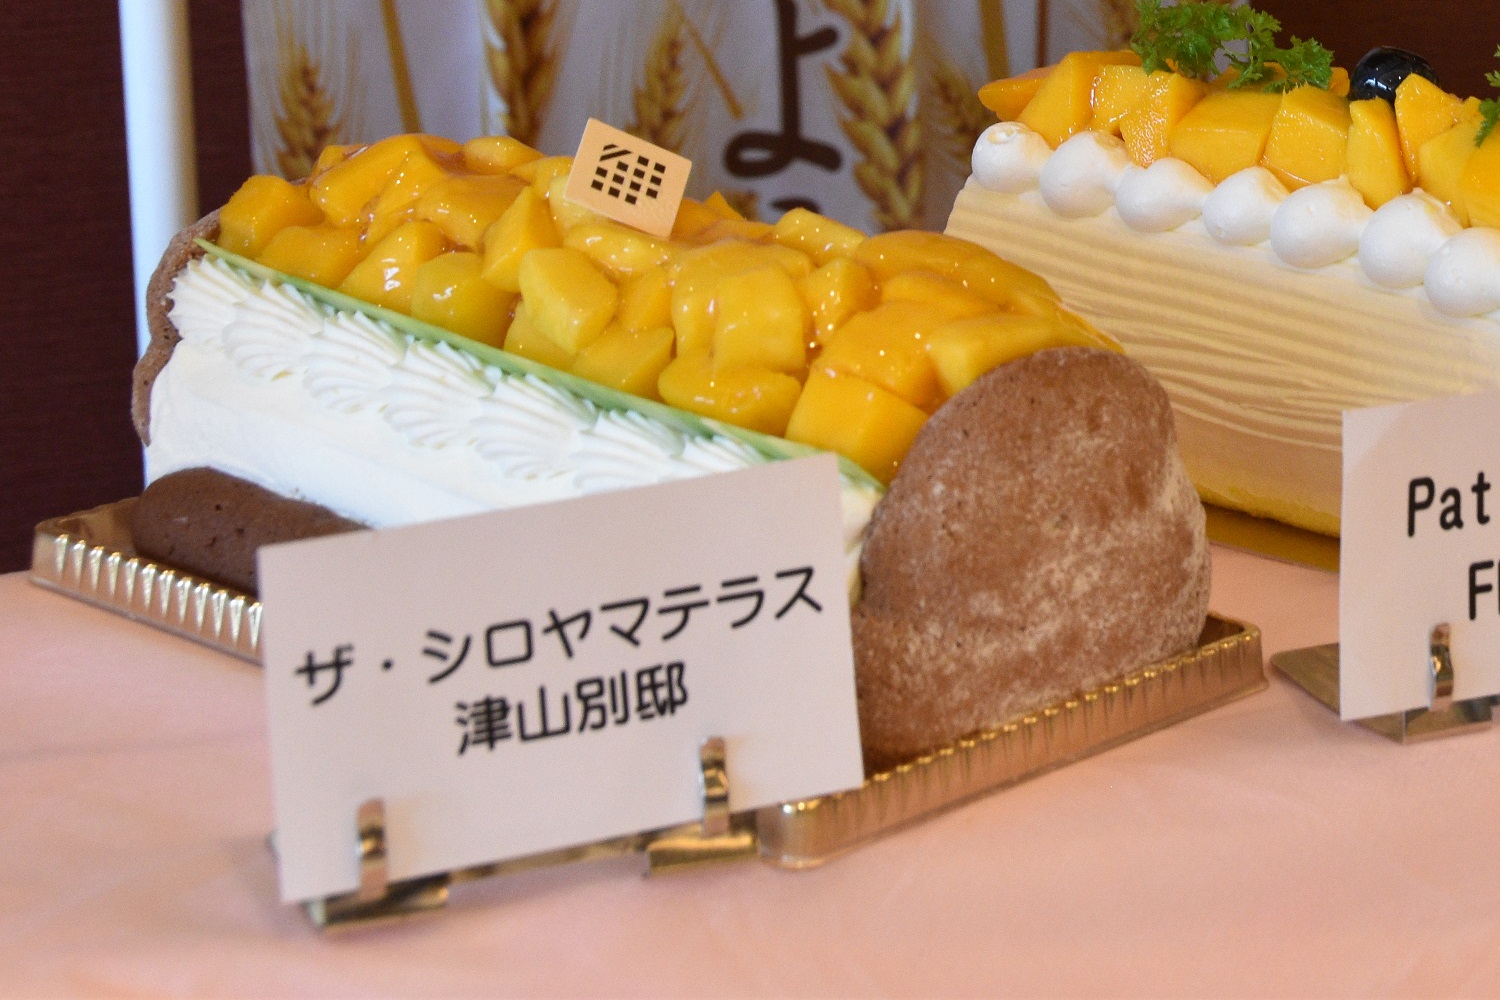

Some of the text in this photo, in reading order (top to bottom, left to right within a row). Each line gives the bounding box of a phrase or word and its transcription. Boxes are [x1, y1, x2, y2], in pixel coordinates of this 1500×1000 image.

[295, 565, 823, 707] ザ・シロヤマテラス
[456, 660, 689, 756] 津山別邸
